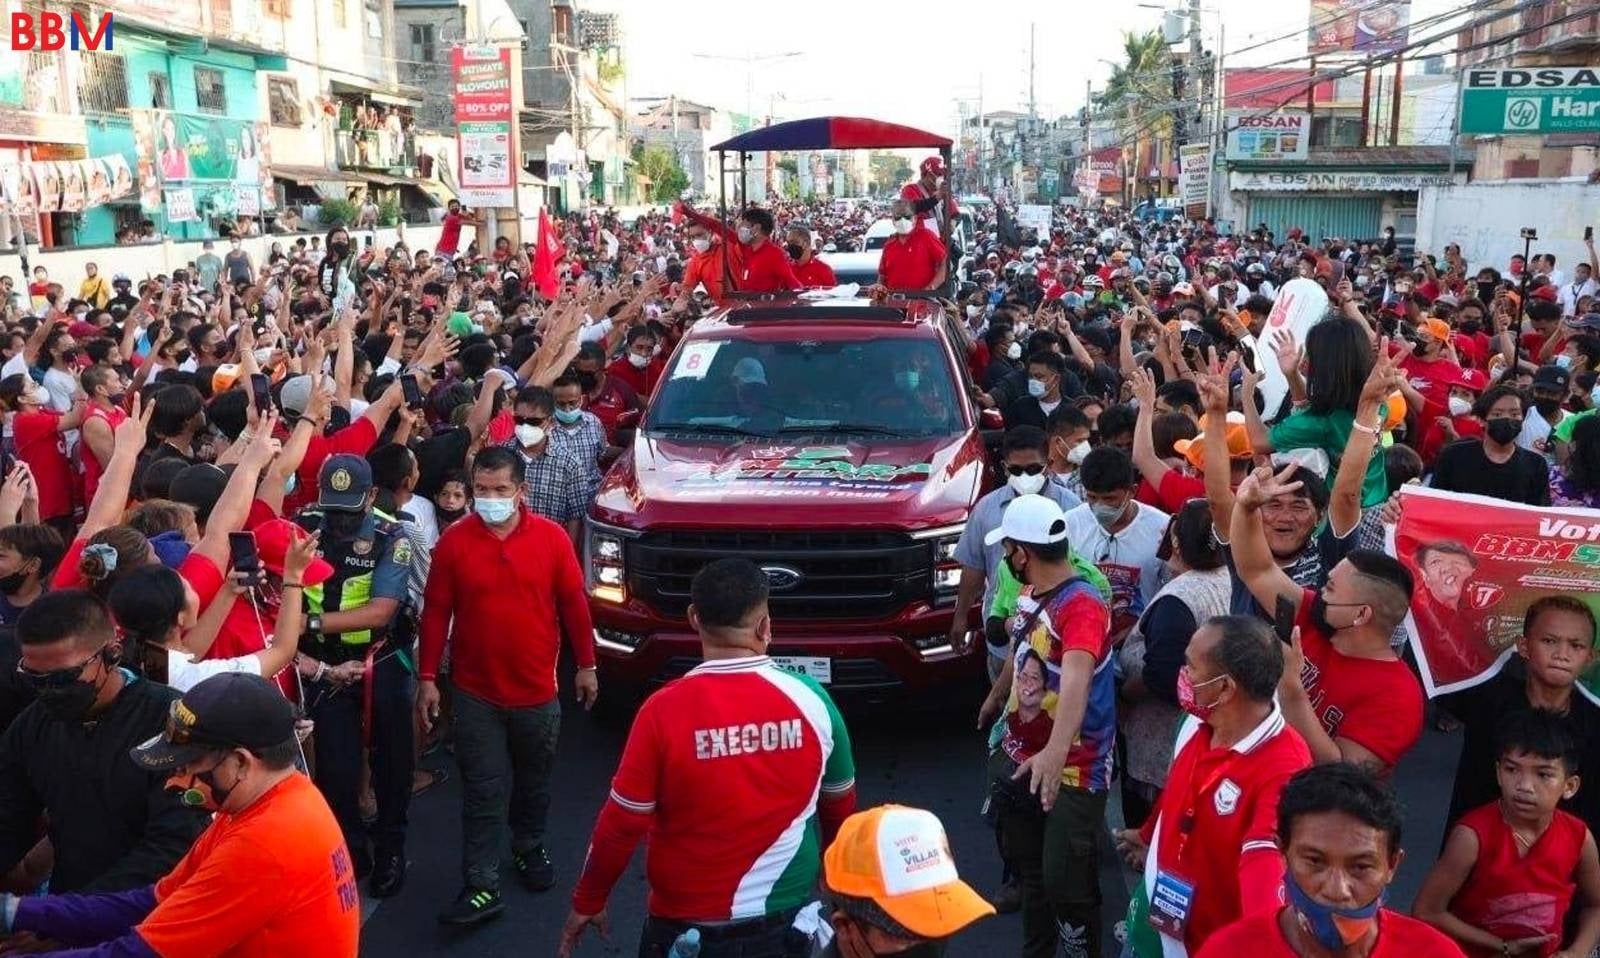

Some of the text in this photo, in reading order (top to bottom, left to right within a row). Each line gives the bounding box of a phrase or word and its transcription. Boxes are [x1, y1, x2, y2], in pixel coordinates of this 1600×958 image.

[461, 62, 503, 75] ULTIMATE
[489, 102, 510, 112] OFF
[1238, 116, 1302, 127] EDSAN
[1268, 174, 1336, 185] EDSAN
[687, 353, 701, 369] 8
[345, 555, 376, 568] POLICE
[694, 718, 803, 760] EXECOM
[904, 848, 939, 865] VILLAR
